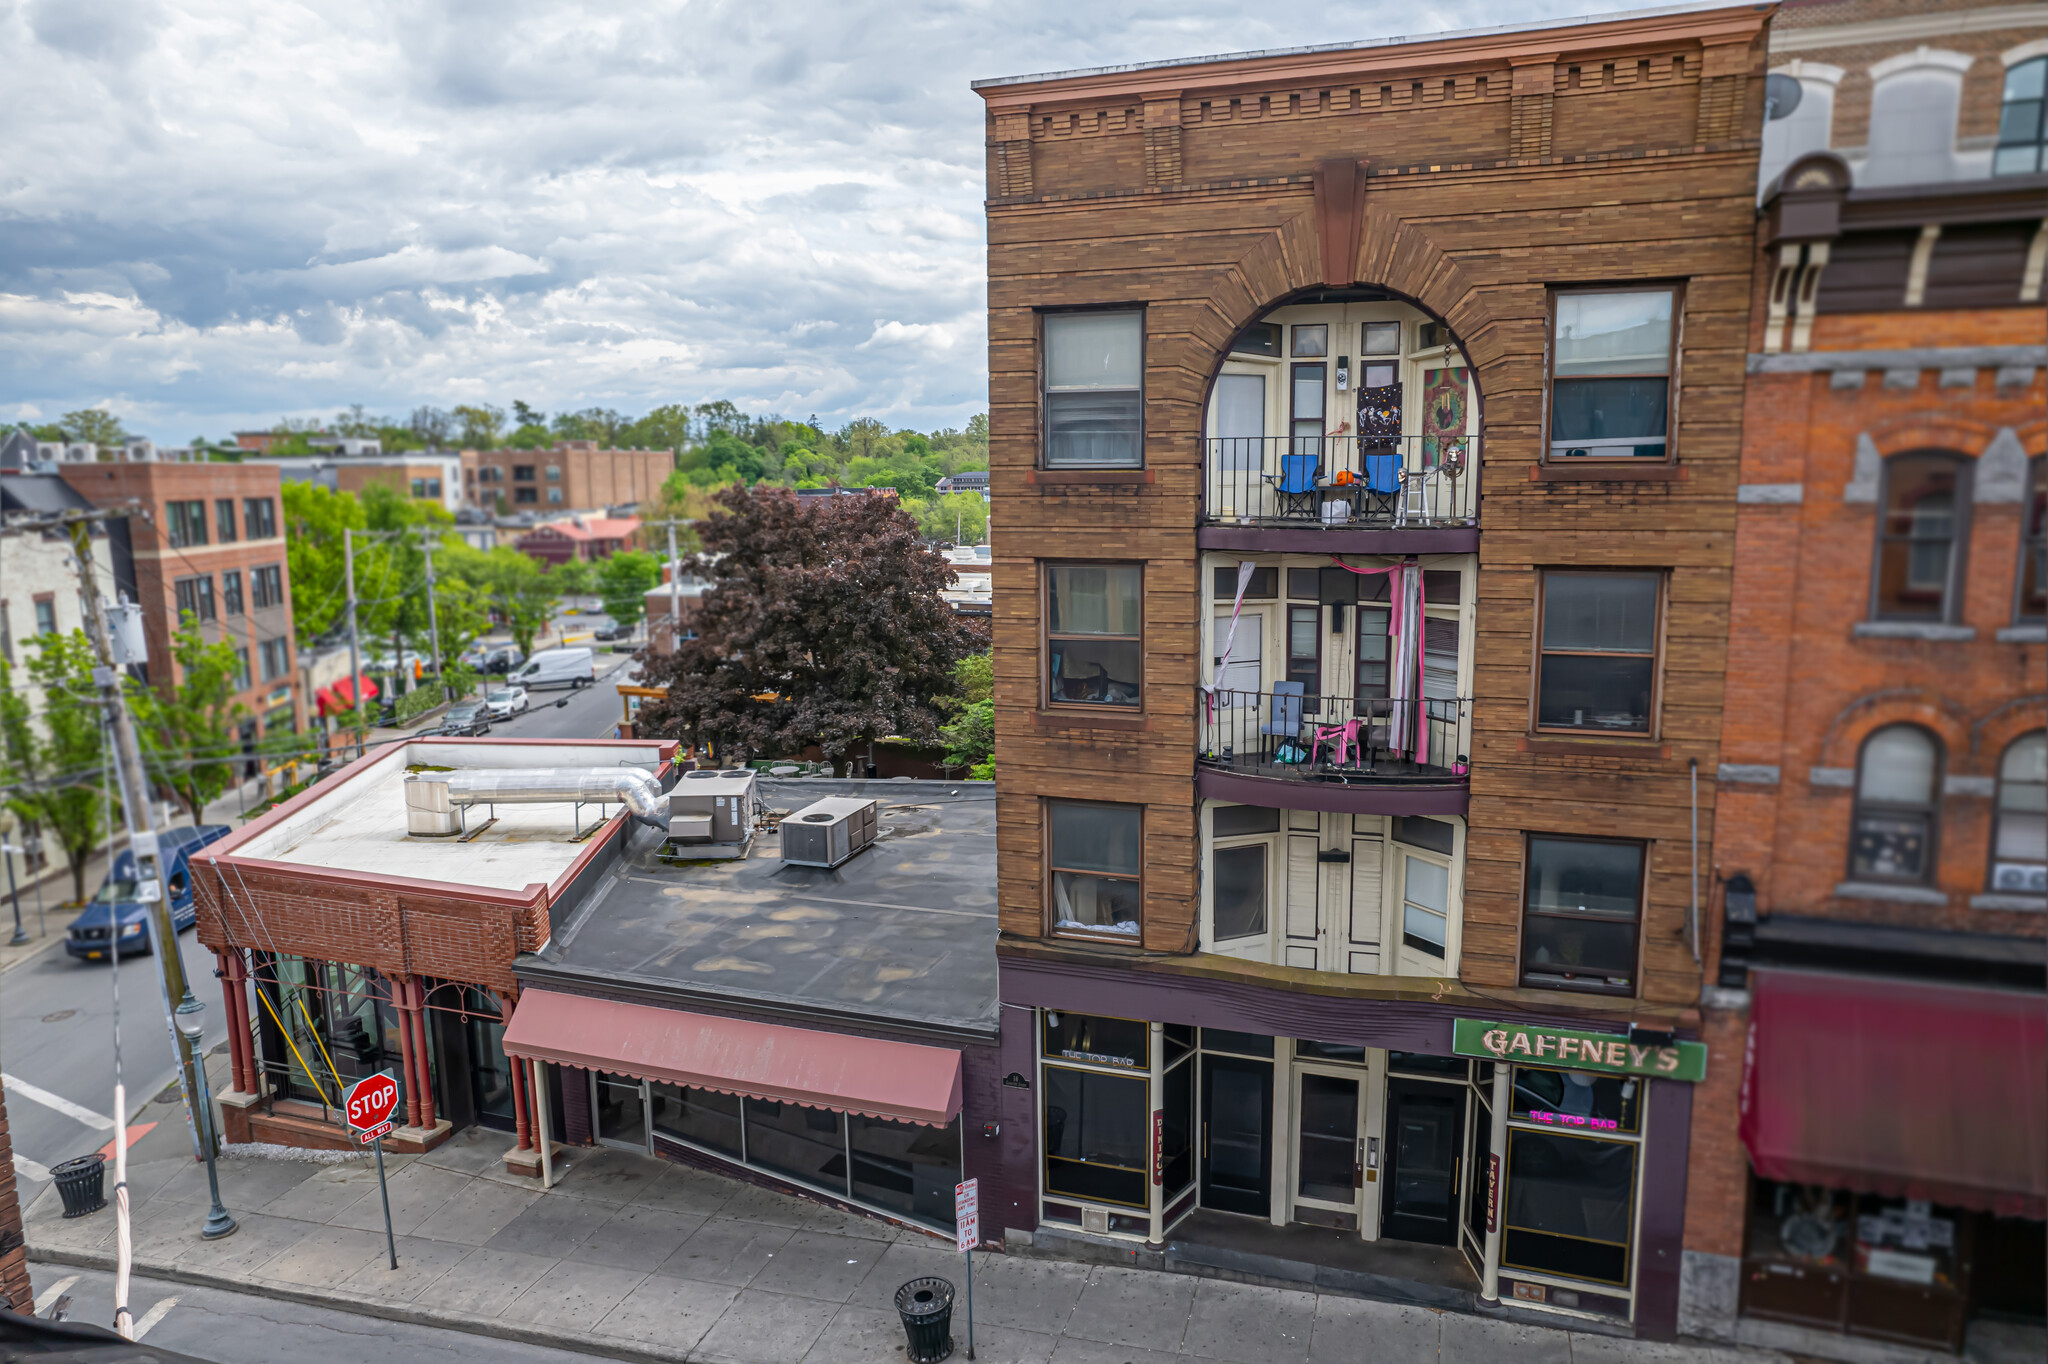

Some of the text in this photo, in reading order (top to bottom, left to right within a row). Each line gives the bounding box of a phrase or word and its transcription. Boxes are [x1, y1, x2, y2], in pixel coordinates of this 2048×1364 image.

[1062, 1049, 1082, 1060] THE
[1482, 1029, 1680, 1072] GAFFNEY'S
[350, 1085, 394, 1119] STOP
[1529, 1110, 1618, 1131] THE TOP BAR
[364, 1124, 389, 1141] ALL WAY
[1487, 1160, 1497, 1219] TAVERN
[964, 1228, 972, 1238] TO
